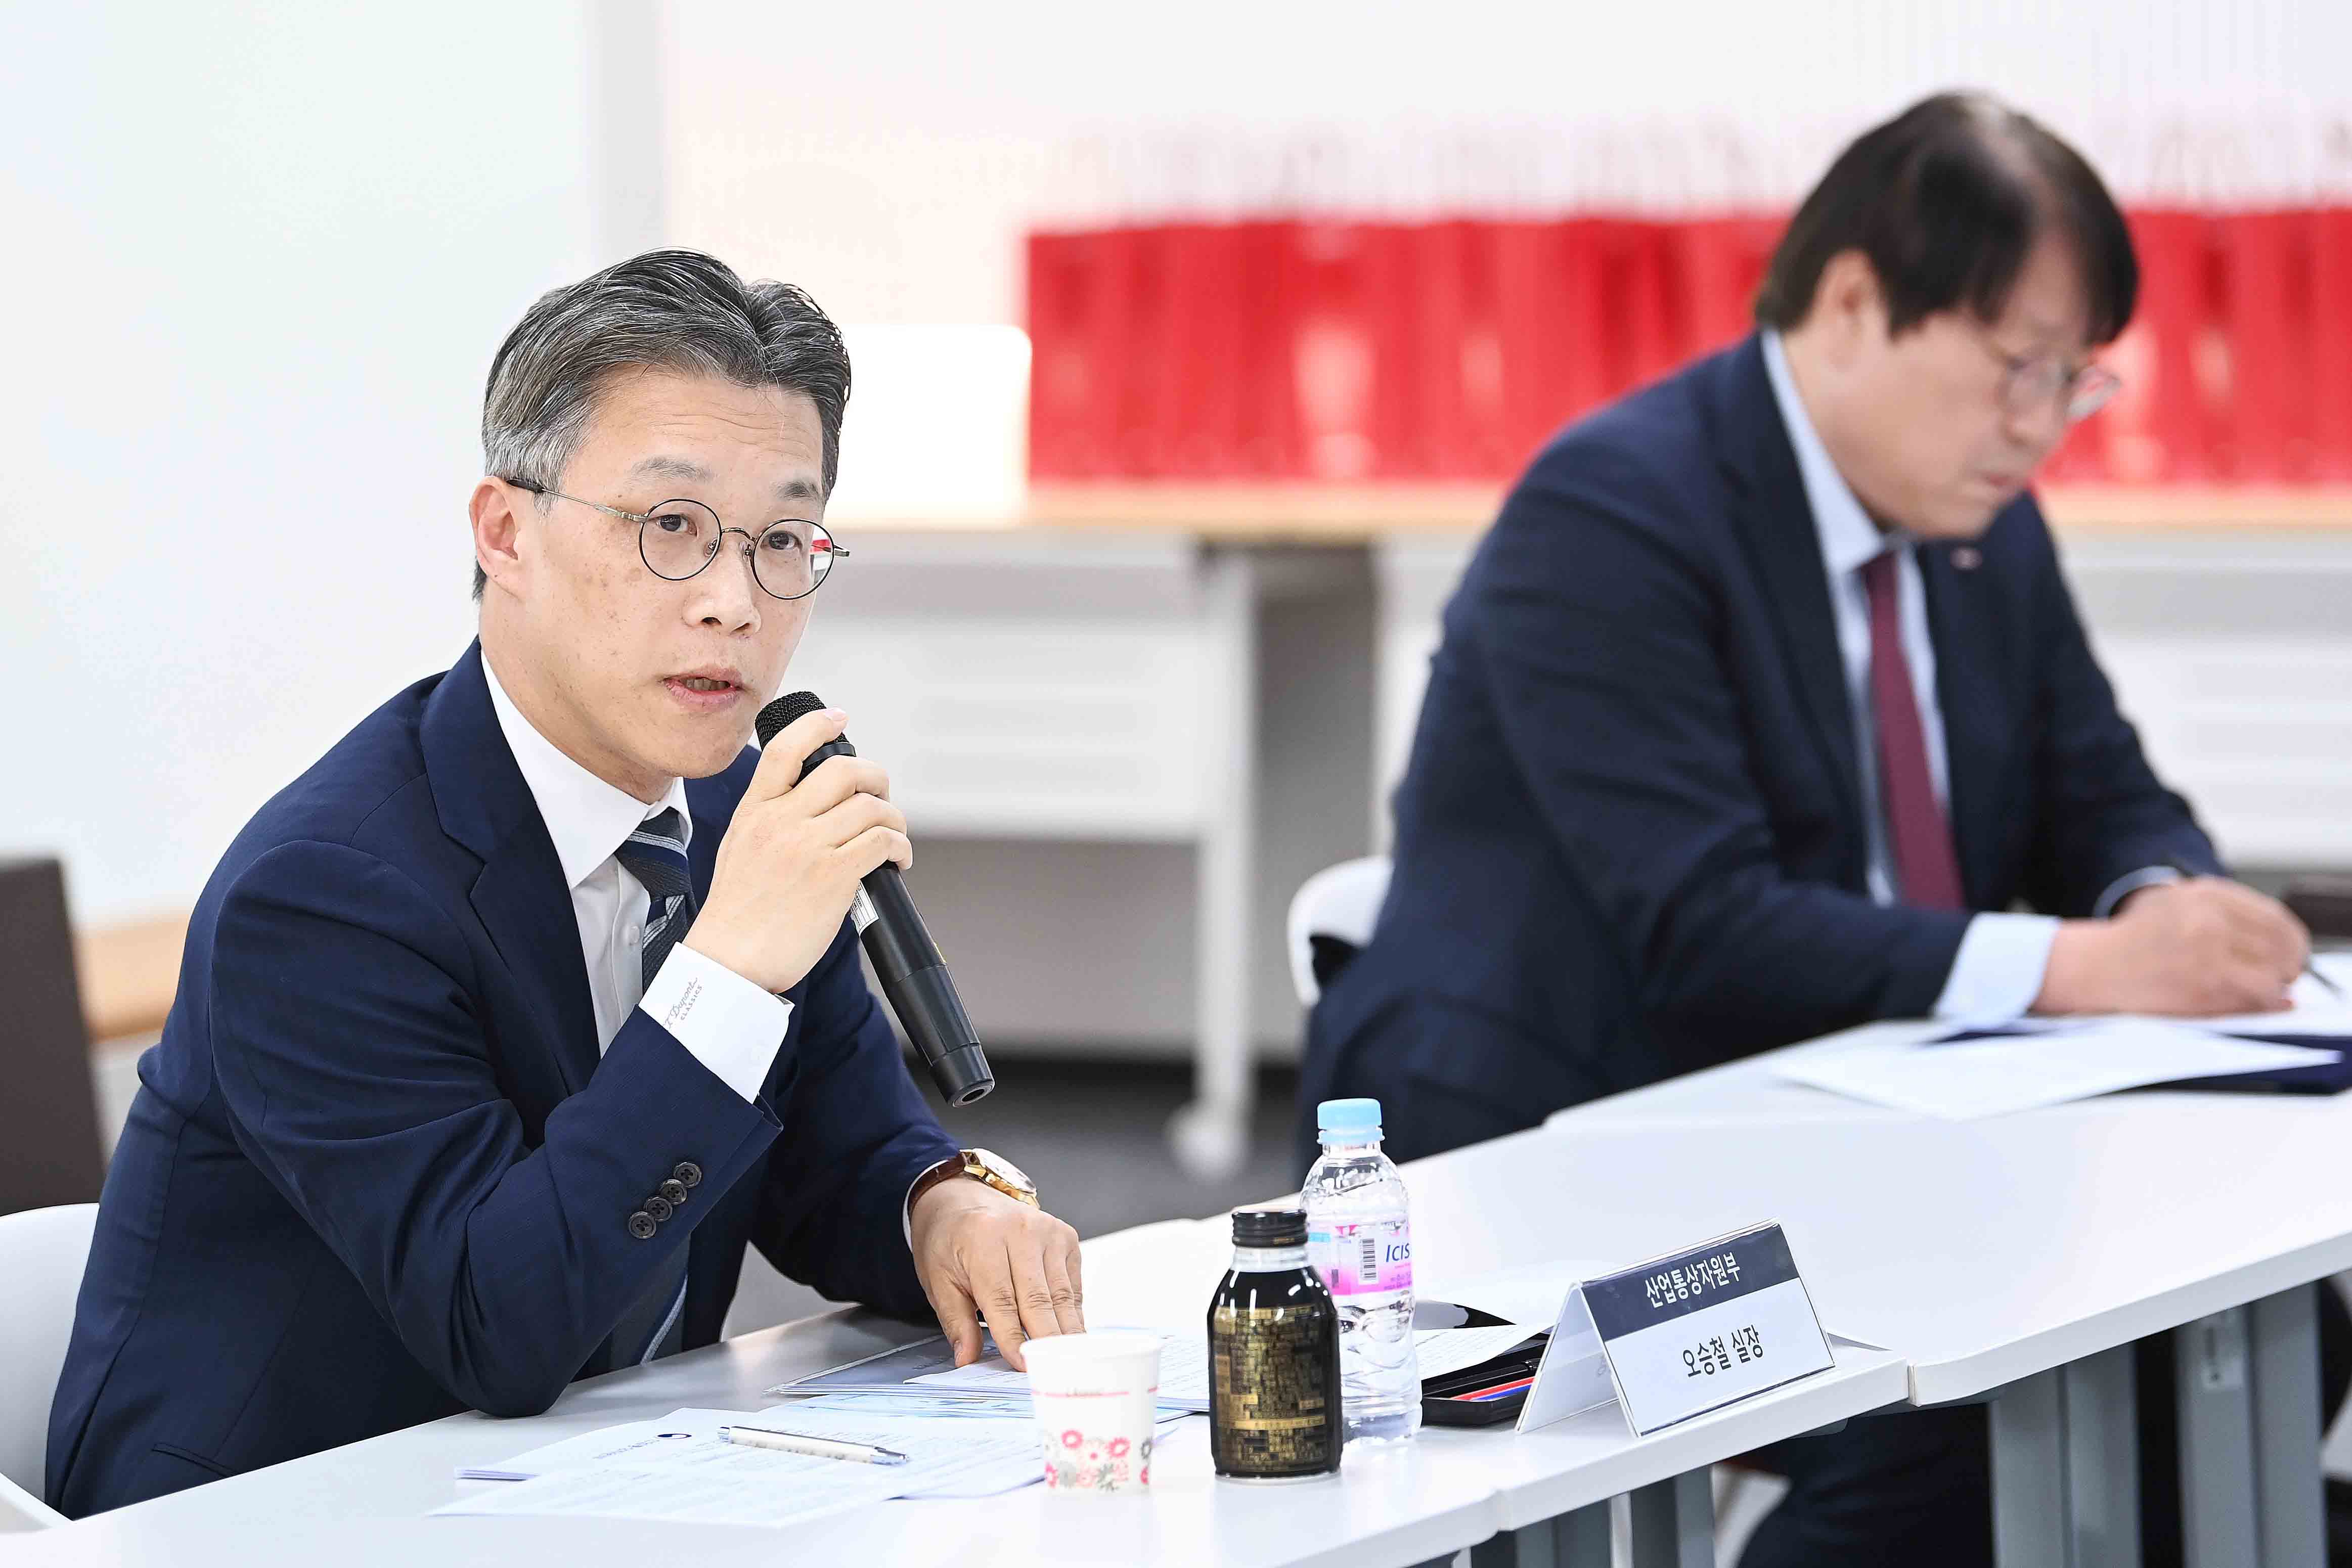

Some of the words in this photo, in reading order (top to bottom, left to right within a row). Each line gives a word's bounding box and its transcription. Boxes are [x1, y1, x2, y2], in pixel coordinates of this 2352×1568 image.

[681, 985, 702, 1020] CLASSICS
[1645, 1252, 1740, 1308] 산업통상자원부
[1682, 1335, 1732, 1377] 오승철
[1732, 1324, 1763, 1364] 실장
